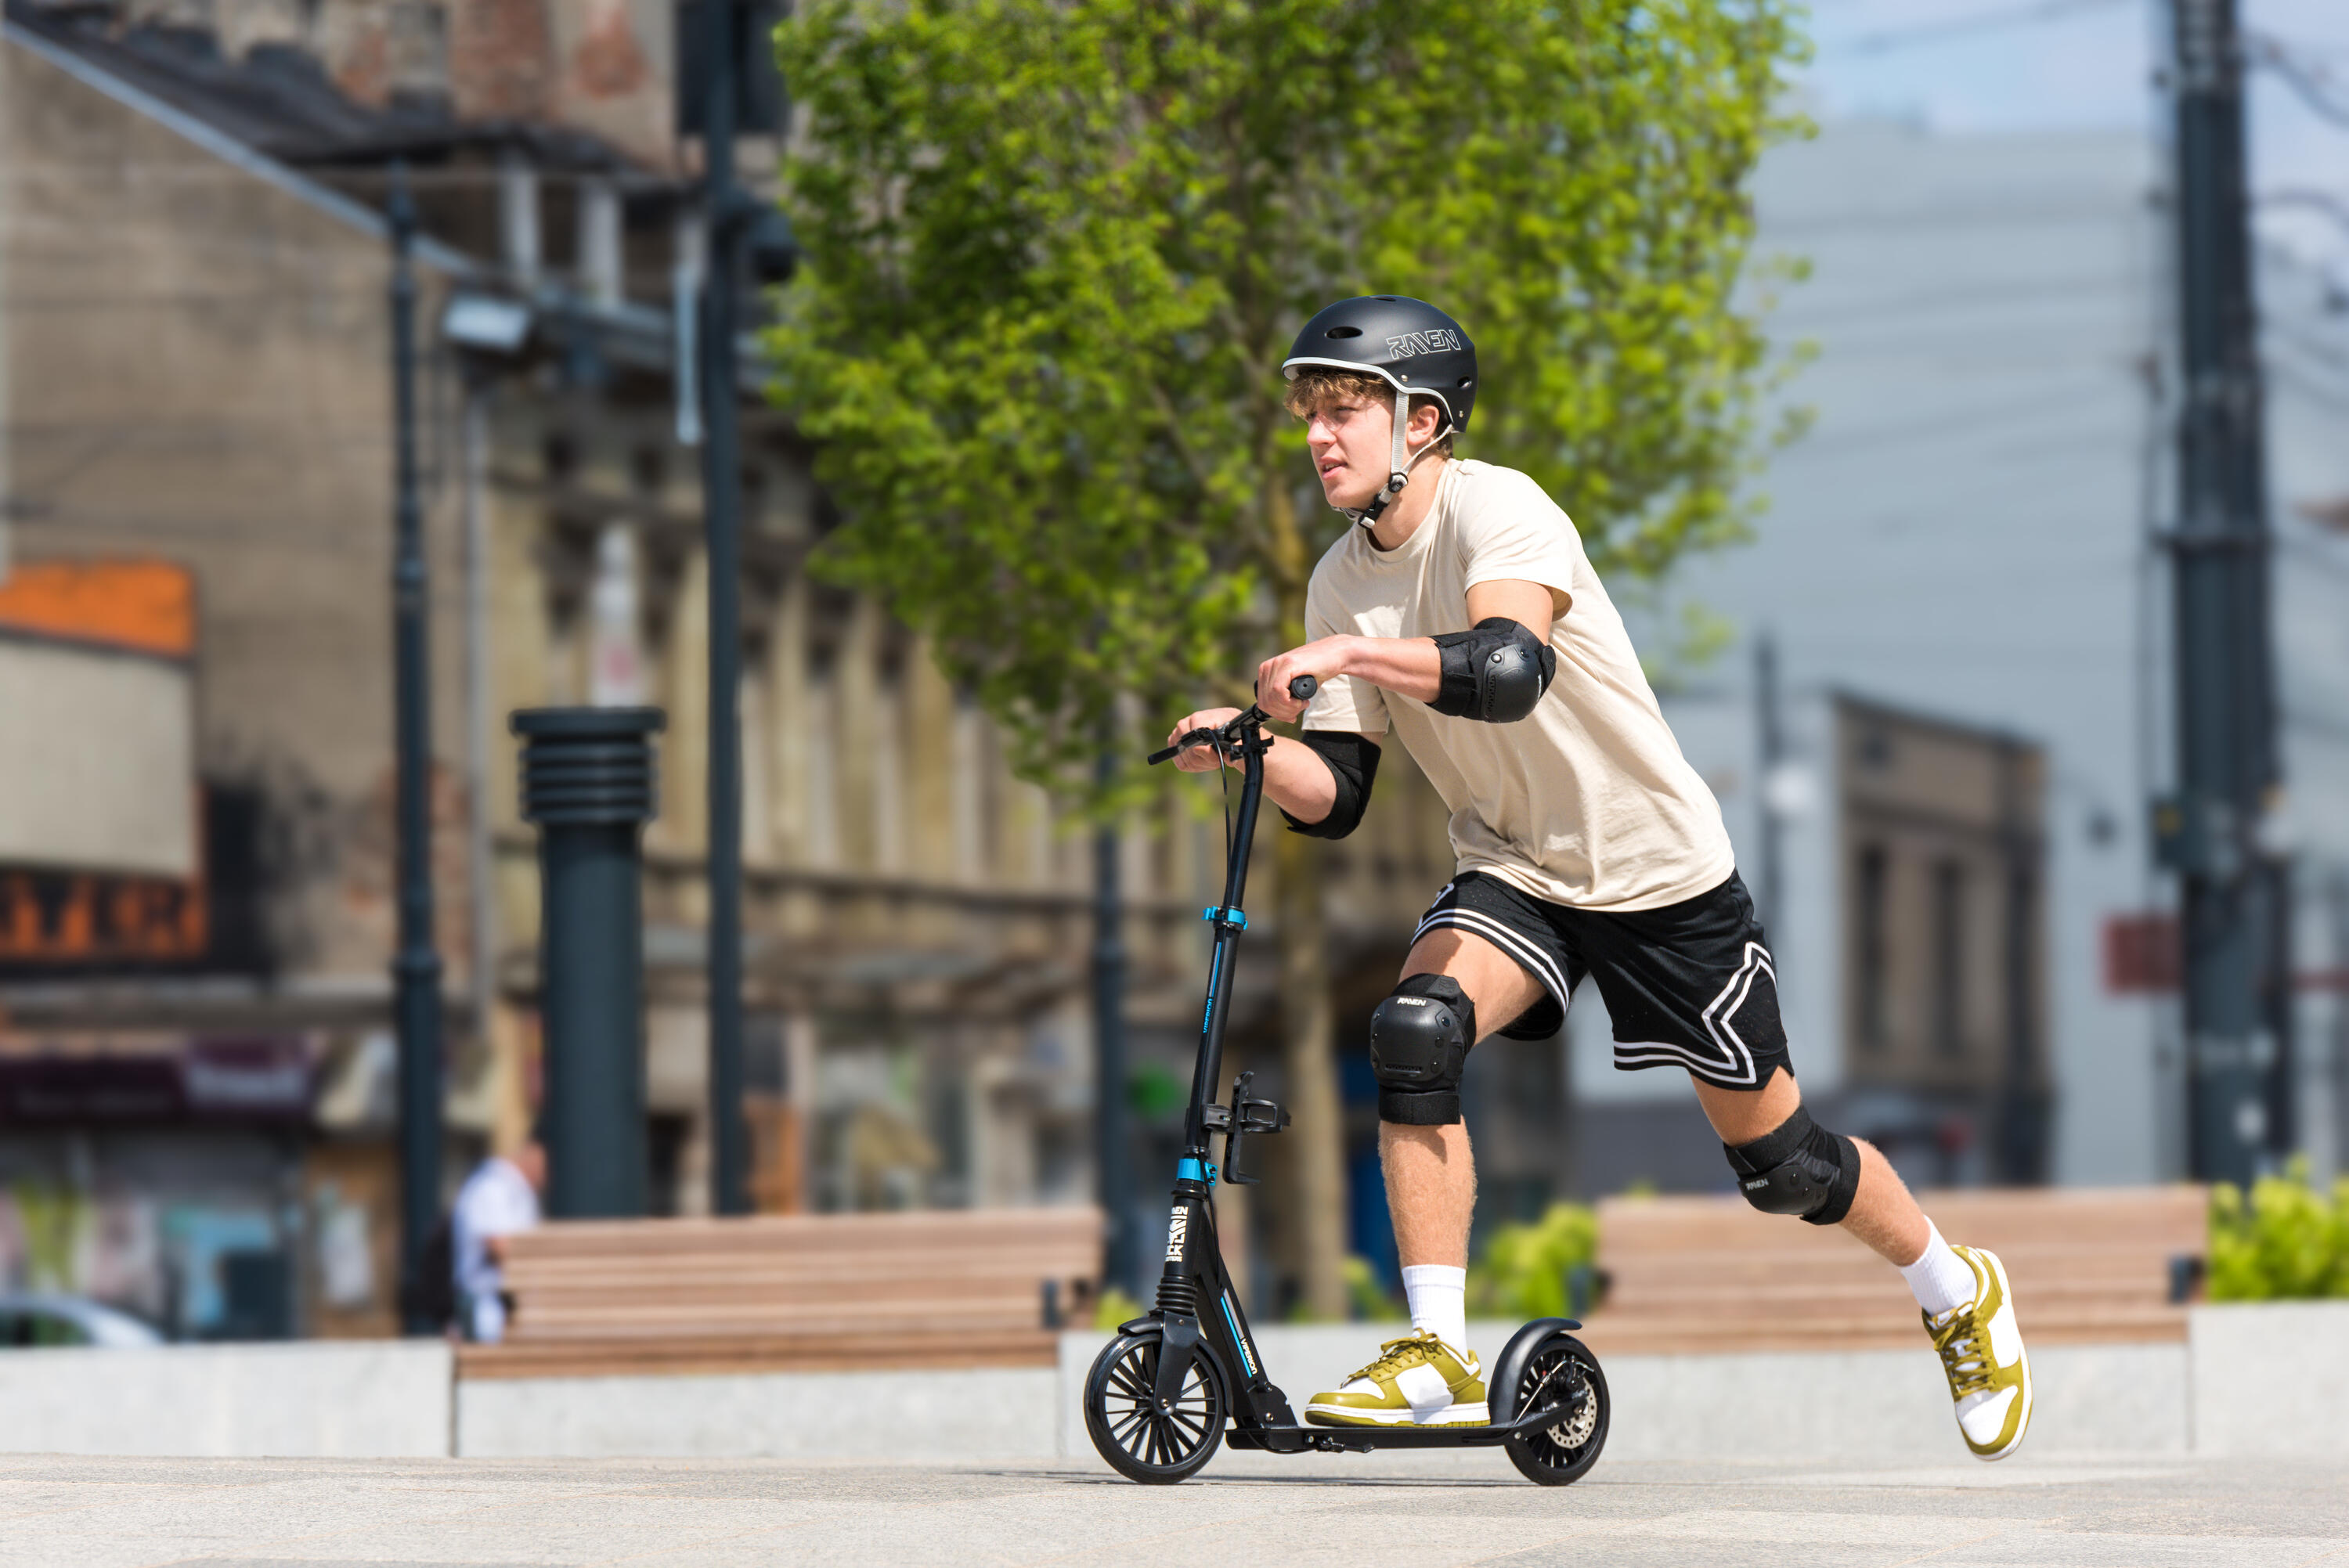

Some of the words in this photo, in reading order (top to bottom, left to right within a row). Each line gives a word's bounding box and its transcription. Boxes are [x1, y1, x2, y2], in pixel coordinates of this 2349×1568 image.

[1386, 329, 1462, 360] RAVEN
[1397, 997, 1427, 1007] RAVEN
[1240, 1338, 1258, 1375] VIPERION
